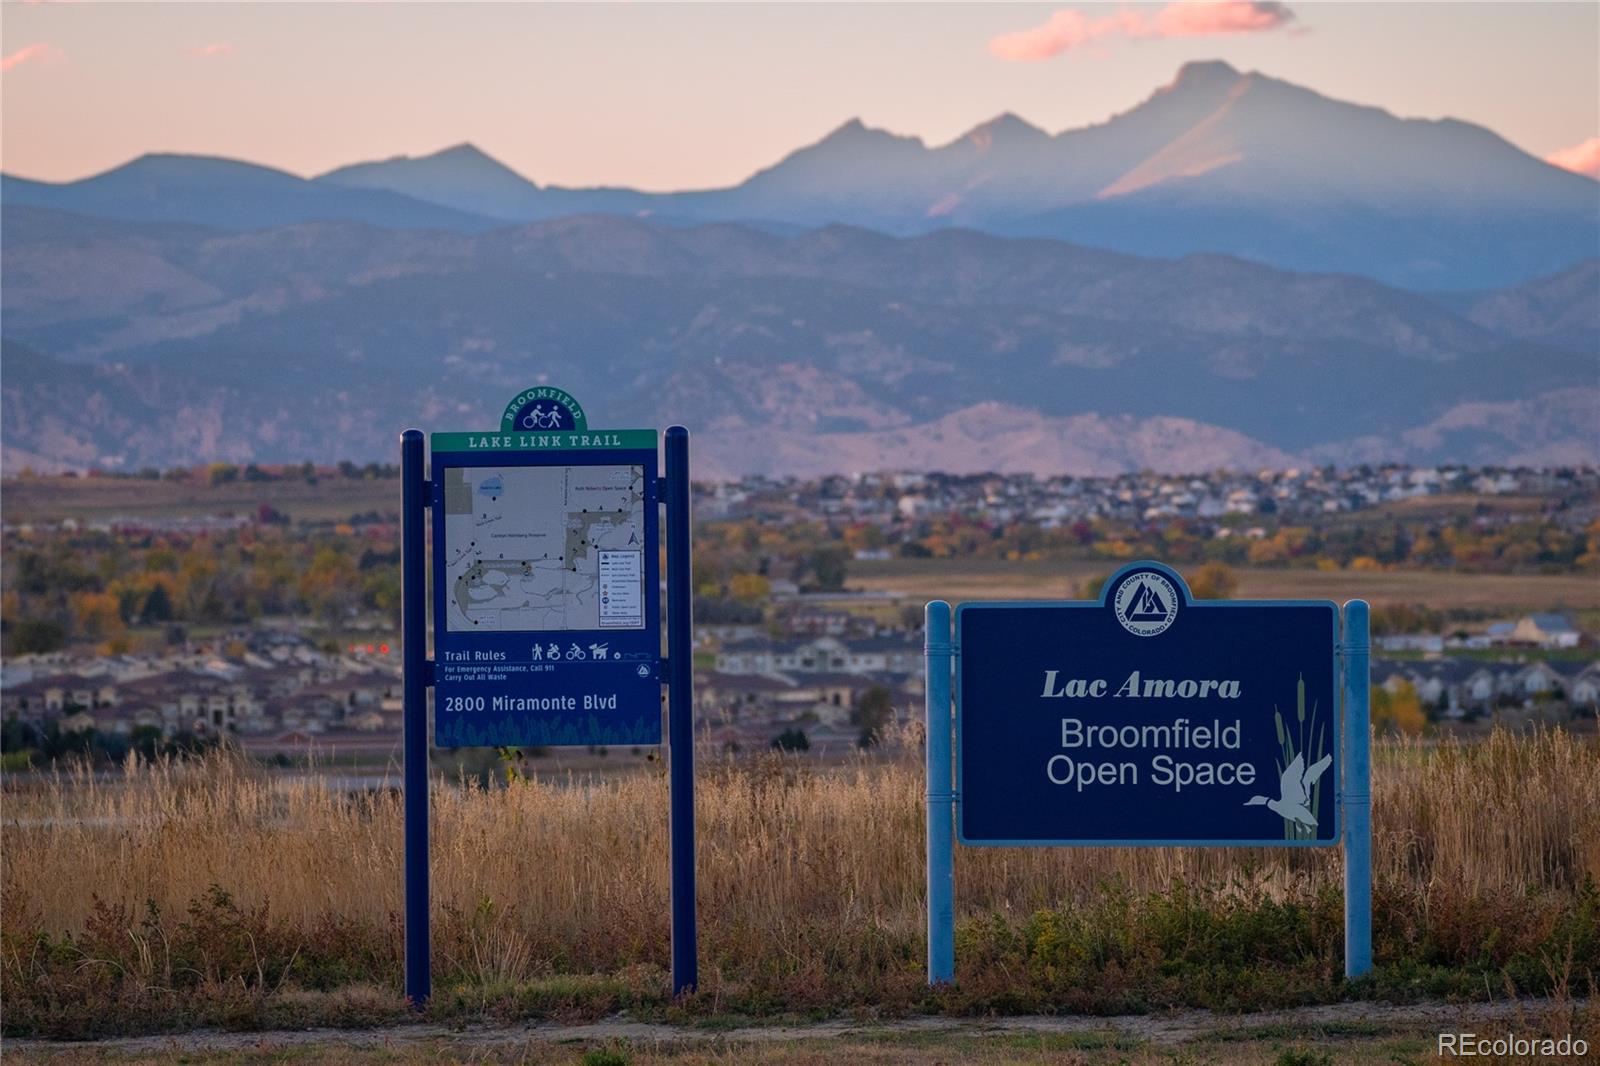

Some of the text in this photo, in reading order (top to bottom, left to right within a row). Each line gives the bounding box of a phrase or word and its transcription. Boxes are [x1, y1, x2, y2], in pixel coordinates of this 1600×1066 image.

[505, 389, 581, 421] BROOMFIELD
[468, 435, 621, 448] LAKE LINK TRAIL
[1122, 574, 1149, 589] COUNTY
[1116, 590, 1124, 604] AND
[1161, 580, 1177, 623] BROOMFIELD
[1116, 607, 1126, 623] CITY
[1128, 625, 1165, 635] COLORADO
[445, 650, 506, 661] Trail Rules
[445, 665, 455, 673] For
[456, 665, 491, 674] Emergency
[530, 664, 543, 672] Call
[544, 664, 555, 672] 911
[445, 673, 507, 682] Carry Out All Waste
[1040, 670, 1242, 699] Lac Amora
[445, 694, 617, 712] 2800 Miramonte Blvd
[1061, 718, 1241, 749] Broomfield
[1046, 754, 1256, 792] Open Space
